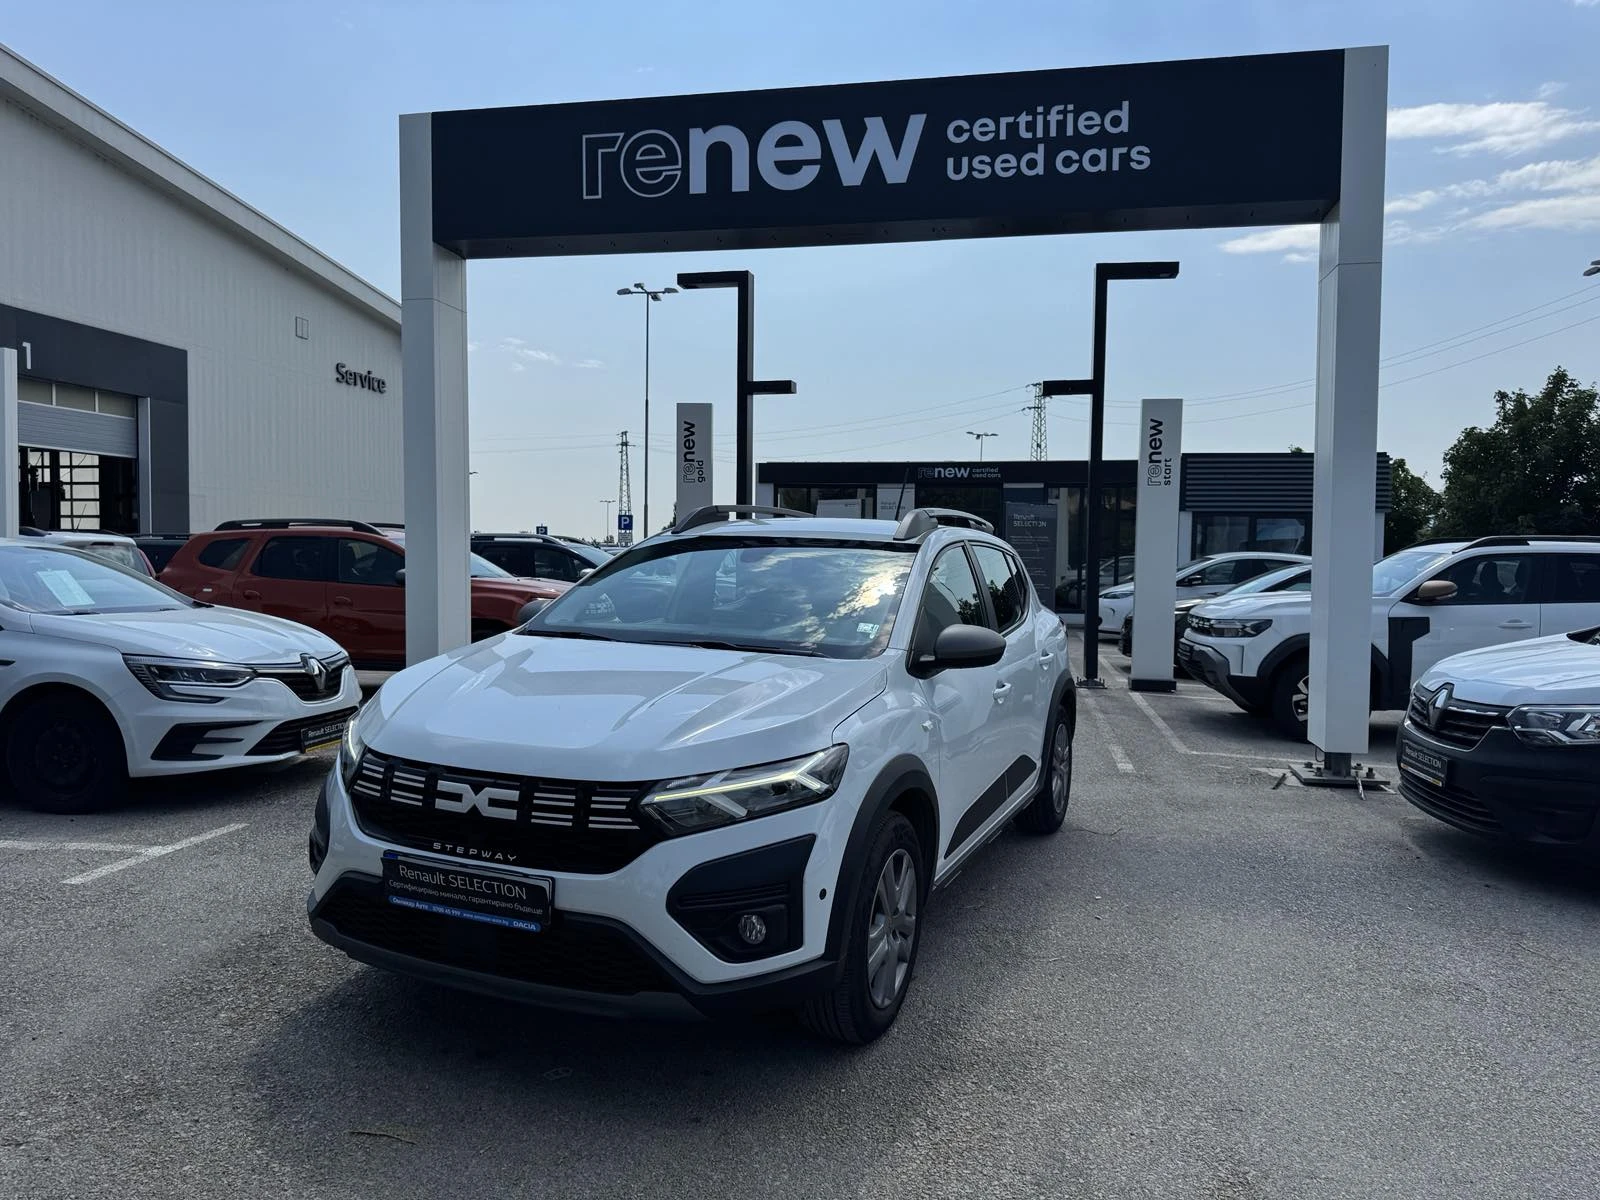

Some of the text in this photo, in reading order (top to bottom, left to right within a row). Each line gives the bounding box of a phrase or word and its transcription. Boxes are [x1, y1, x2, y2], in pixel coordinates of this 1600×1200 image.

[946, 100, 1129, 144] certified
[582, 113, 927, 199] renew
[946, 143, 1151, 181] used cars
[22, 341, 32, 370] 1
[335, 362, 386, 394] Service
[683, 420, 696, 483] renew
[1147, 418, 1163, 486] renew
[696, 460, 706, 483] gold
[917, 466, 970, 479] renew
[1164, 458, 1172, 486] start
[538, 527, 546, 535] P
[621, 516, 630, 529] P
[433, 842, 517, 861] STEPWAY
[399, 864, 527, 900] Renault SELECTION
[513, 921, 537, 931] DACIA
